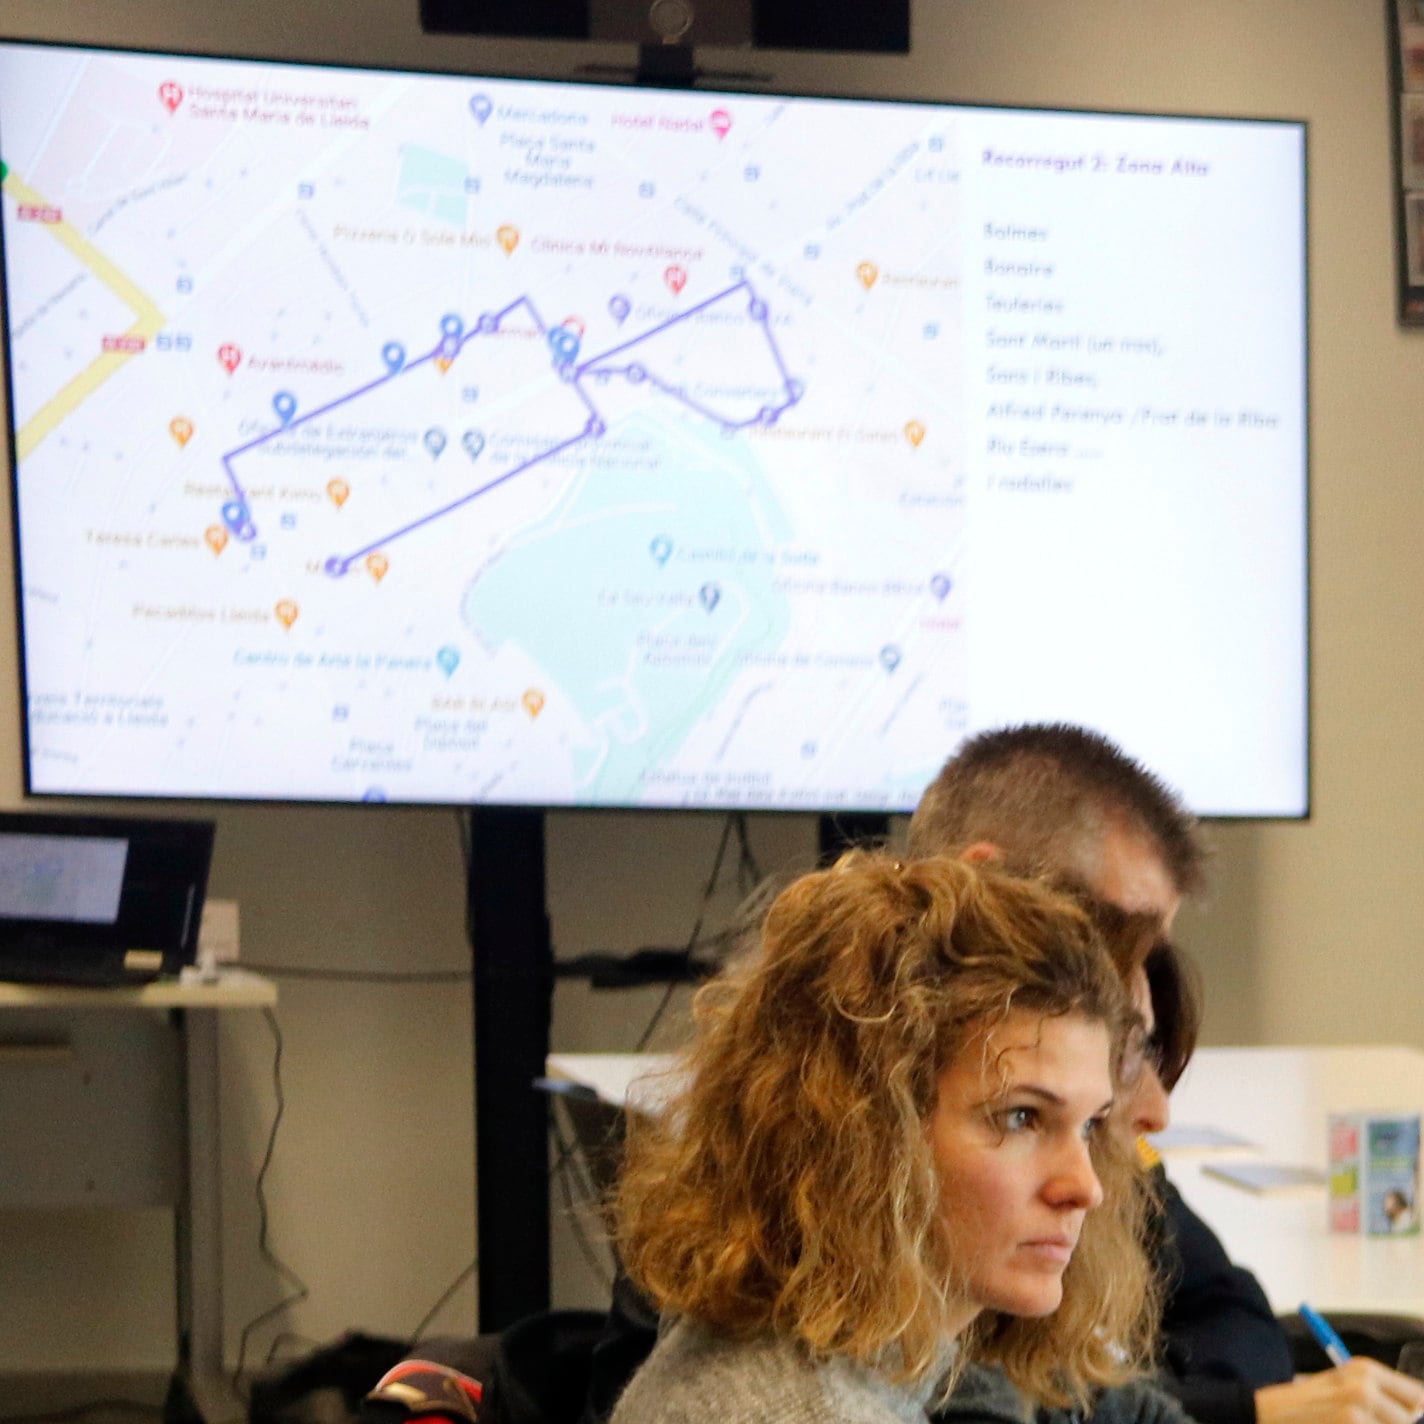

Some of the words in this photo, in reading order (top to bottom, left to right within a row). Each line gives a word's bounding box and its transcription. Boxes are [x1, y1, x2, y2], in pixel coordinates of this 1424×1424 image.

[981, 147, 1084, 174] Recorregut
[1115, 153, 1164, 175] Zona
[1170, 157, 1211, 178] Alta
[982, 221, 1049, 243] Balmes
